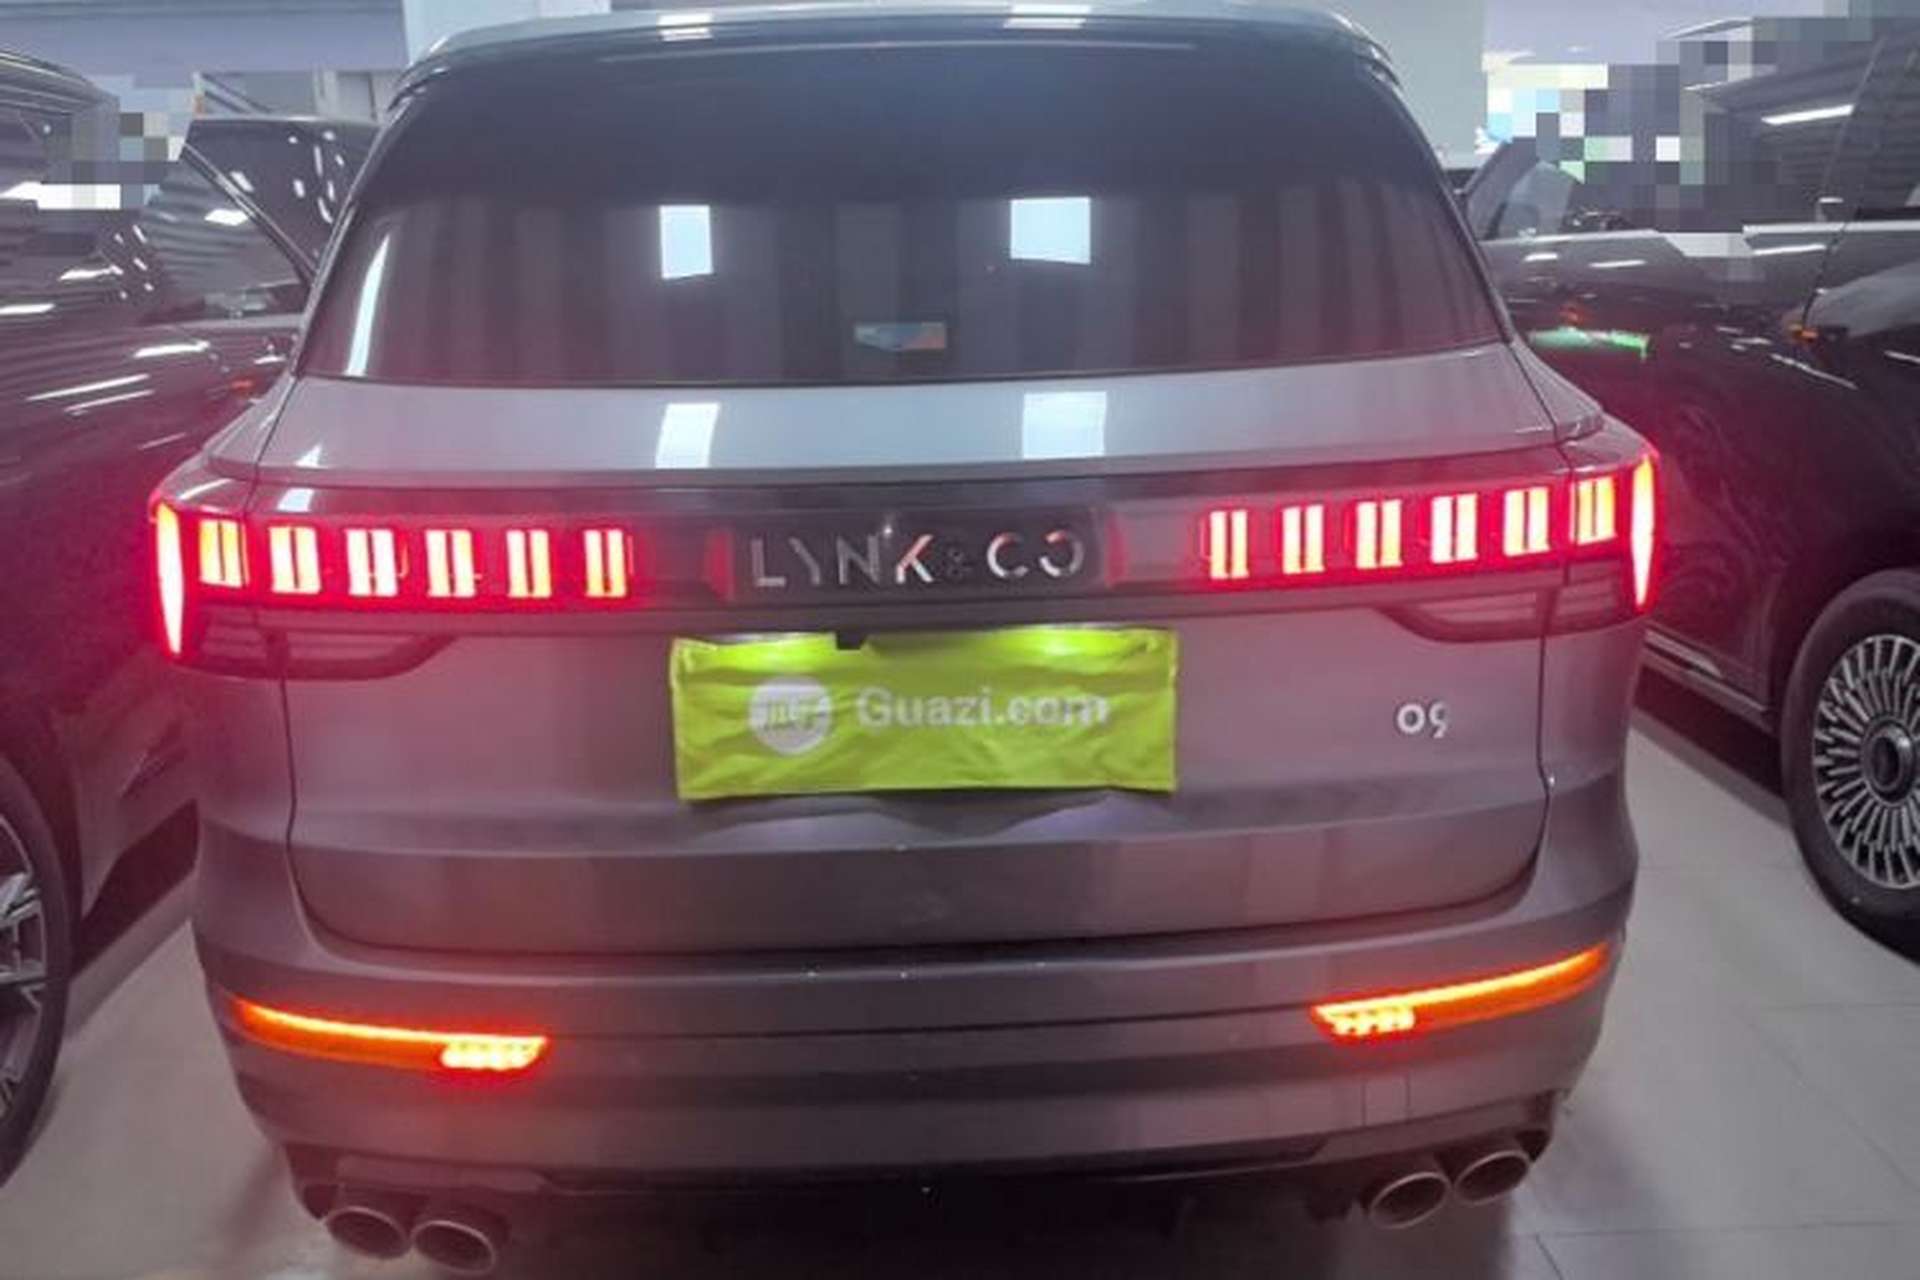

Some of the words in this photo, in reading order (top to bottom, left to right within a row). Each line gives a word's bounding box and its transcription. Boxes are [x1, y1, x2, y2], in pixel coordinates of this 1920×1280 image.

[750, 533, 934, 588] LYNK
[986, 529, 1084, 579] CO
[855, 684, 1111, 731] Guazi.com
